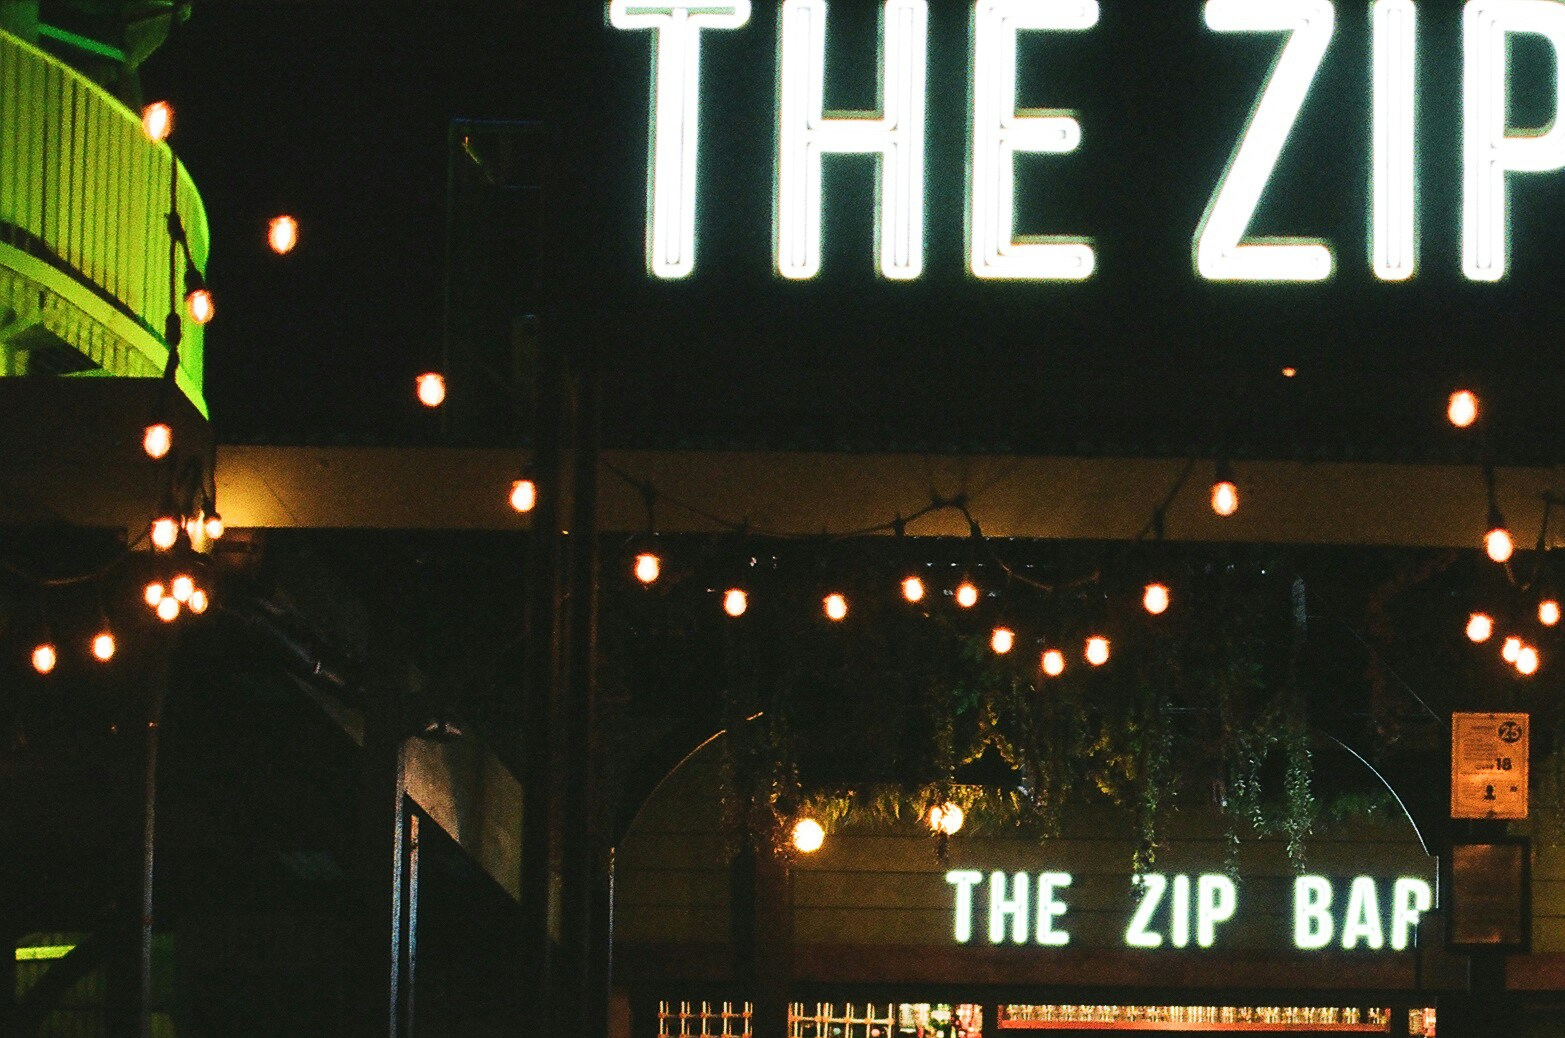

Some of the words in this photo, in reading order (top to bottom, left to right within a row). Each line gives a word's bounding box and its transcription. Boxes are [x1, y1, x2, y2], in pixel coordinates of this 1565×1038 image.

[608, 0, 1099, 282] THE
[945, 868, 1074, 947] THE
[1125, 872, 1241, 949] ZIP
